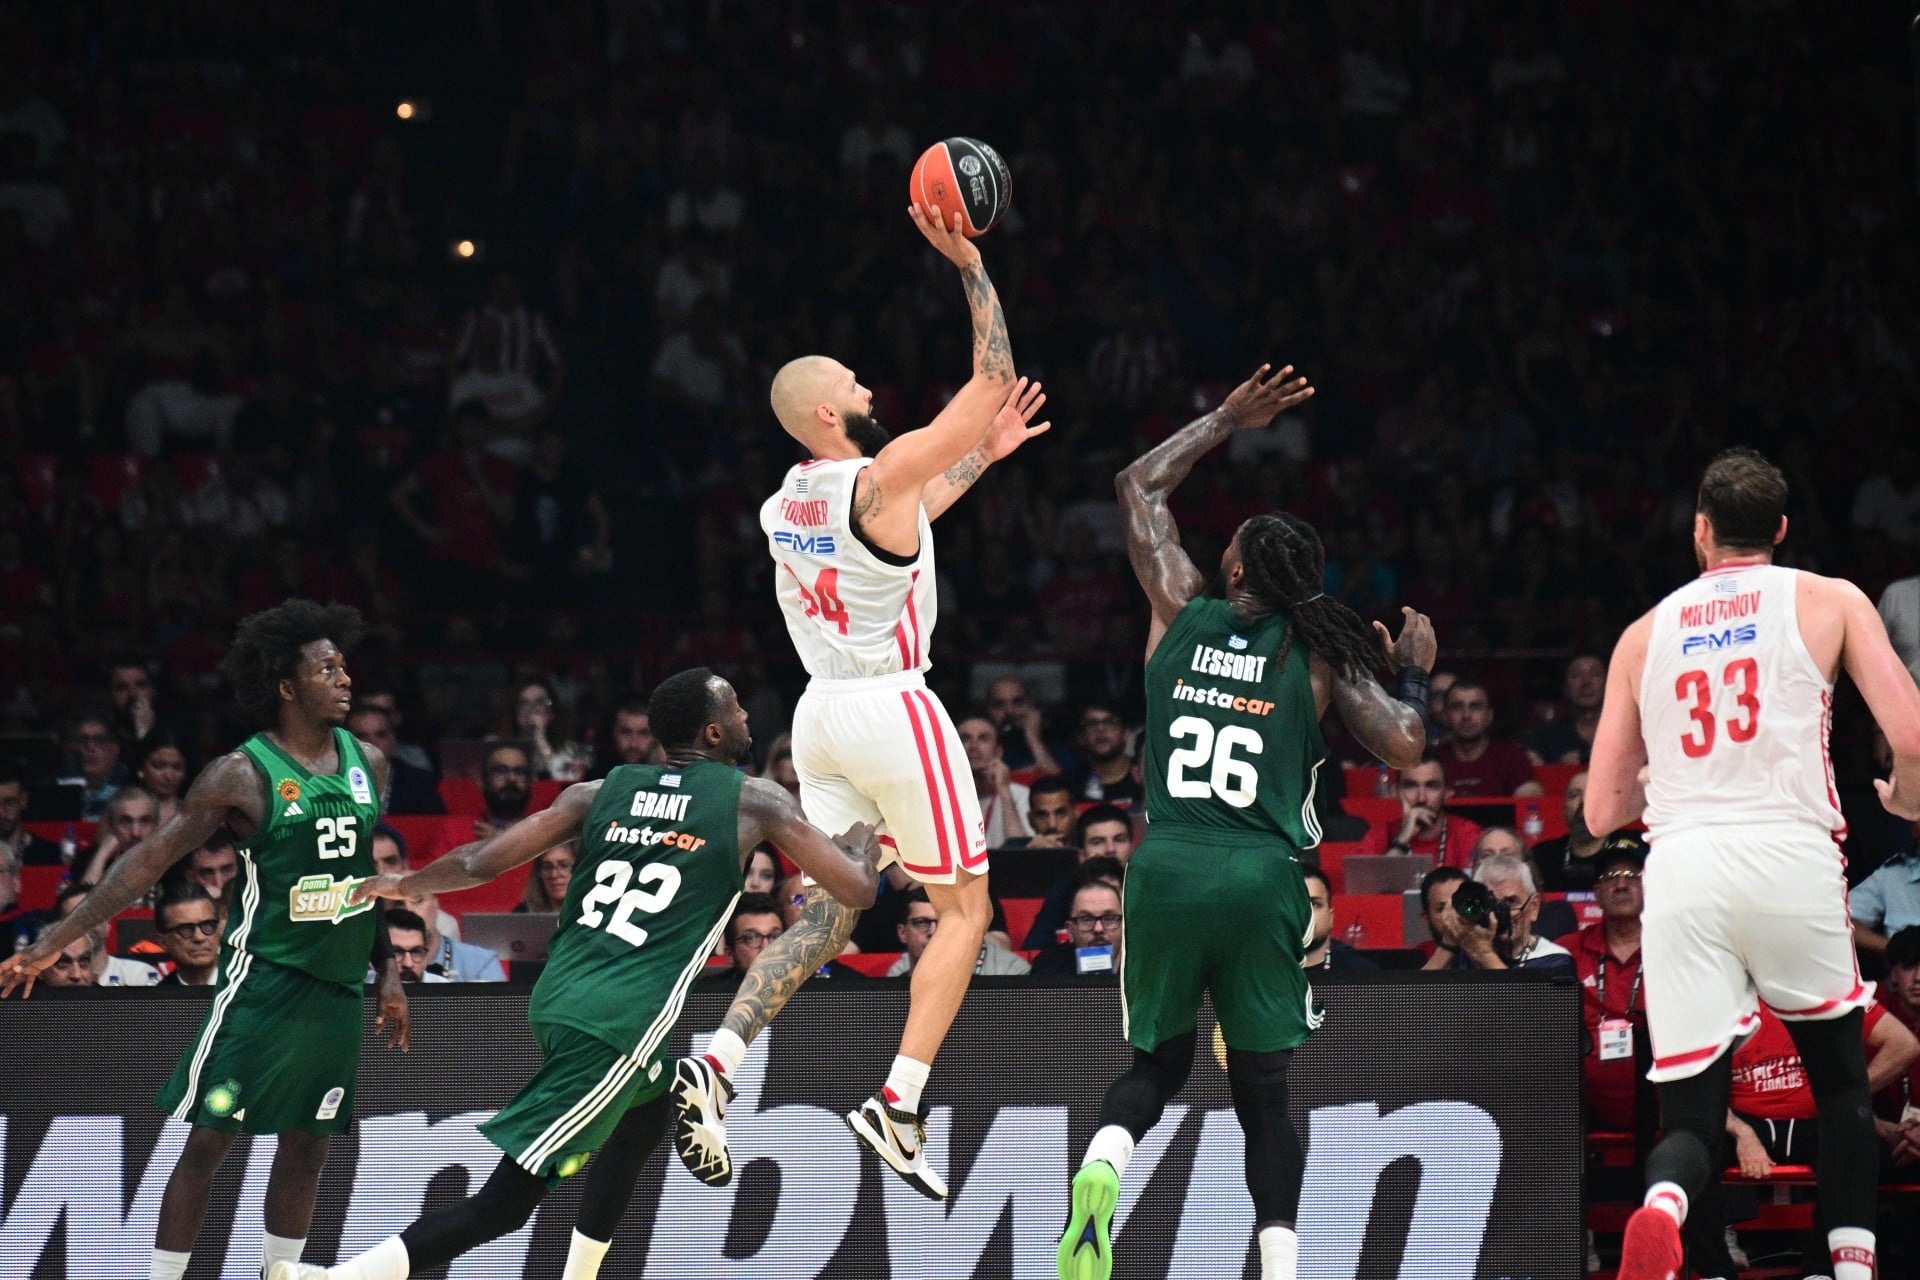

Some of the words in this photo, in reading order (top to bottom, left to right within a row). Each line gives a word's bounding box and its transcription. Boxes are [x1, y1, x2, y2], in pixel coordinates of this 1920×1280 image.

[773, 531, 835, 553] FMS
[1679, 590, 1762, 629] MILUTINOV
[1682, 623, 1757, 655] FMS
[1191, 644, 1267, 683] LESSORT
[1172, 678, 1275, 716] instacar
[1675, 657, 1761, 759] 33
[1167, 715, 1264, 808] 26
[630, 790, 692, 822] GRANT
[315, 816, 357, 860] 25
[605, 820, 706, 852] instacar
[576, 859, 682, 947] 22
[644, 1024, 1503, 1280] bwin
